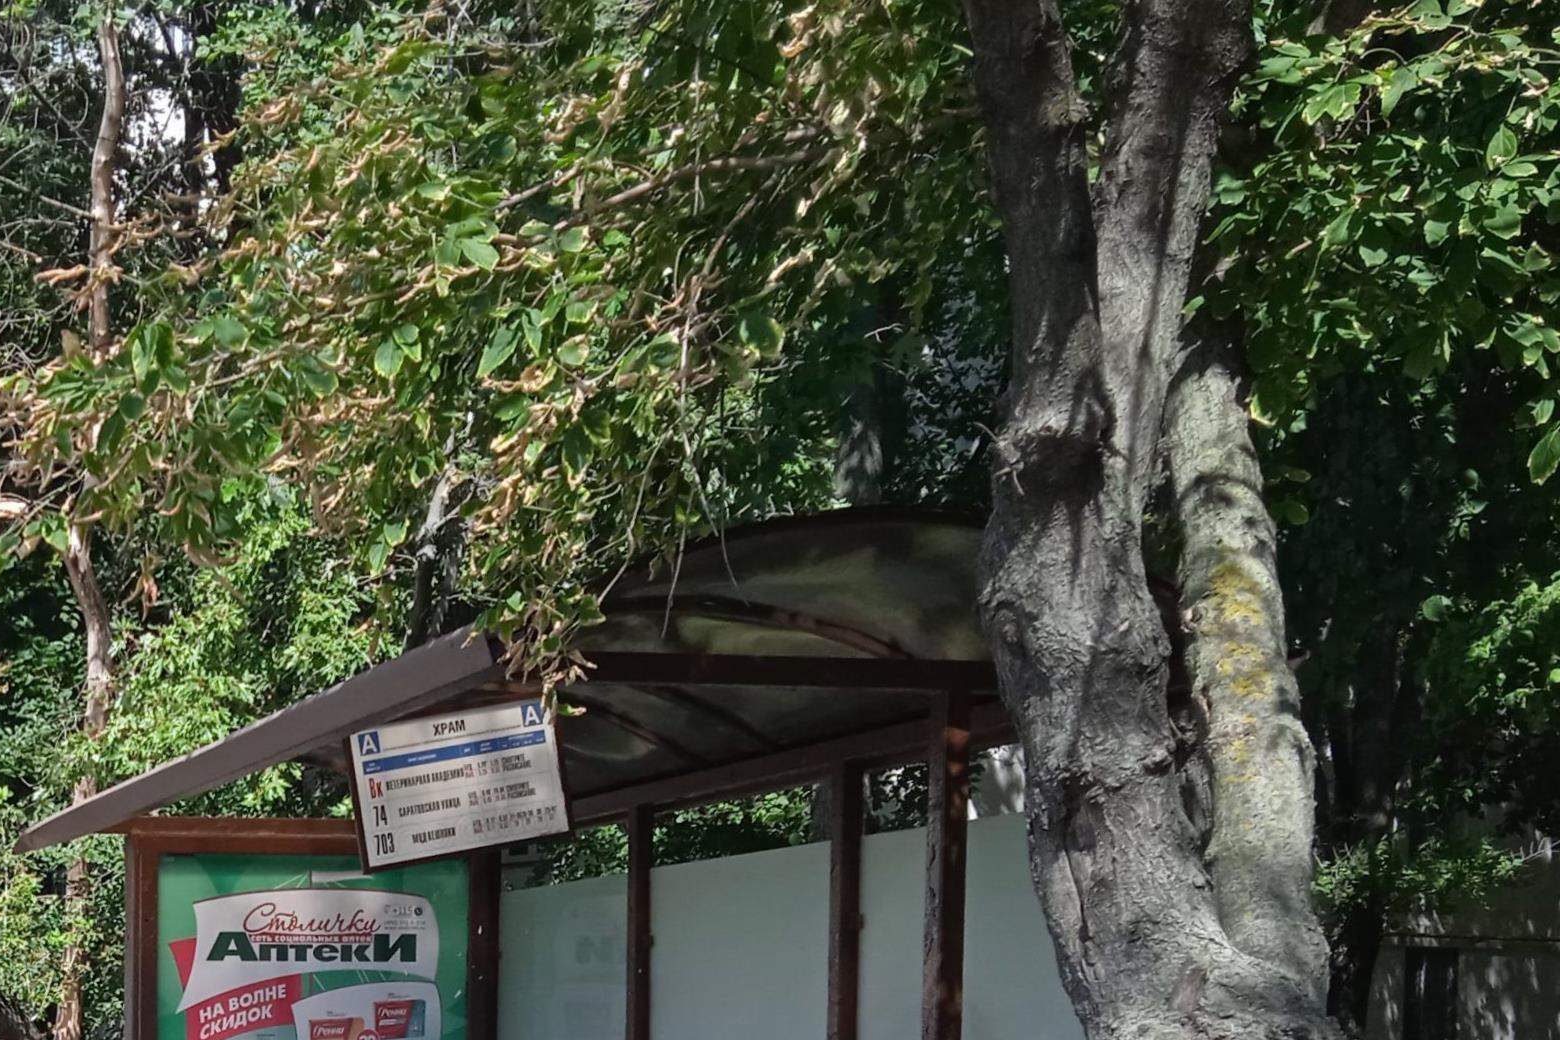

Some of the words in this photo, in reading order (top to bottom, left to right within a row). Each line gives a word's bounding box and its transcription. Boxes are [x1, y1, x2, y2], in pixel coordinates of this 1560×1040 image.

[432, 719, 466, 736] ХРАМ
[372, 805, 388, 827] 74
[373, 832, 395, 856] 703
[243, 902, 381, 934] Столички
[198, 1002, 224, 1024] НА
[227, 984, 287, 1013] ВОЛНЕ
[199, 1006, 274, 1040] СКИДОК
